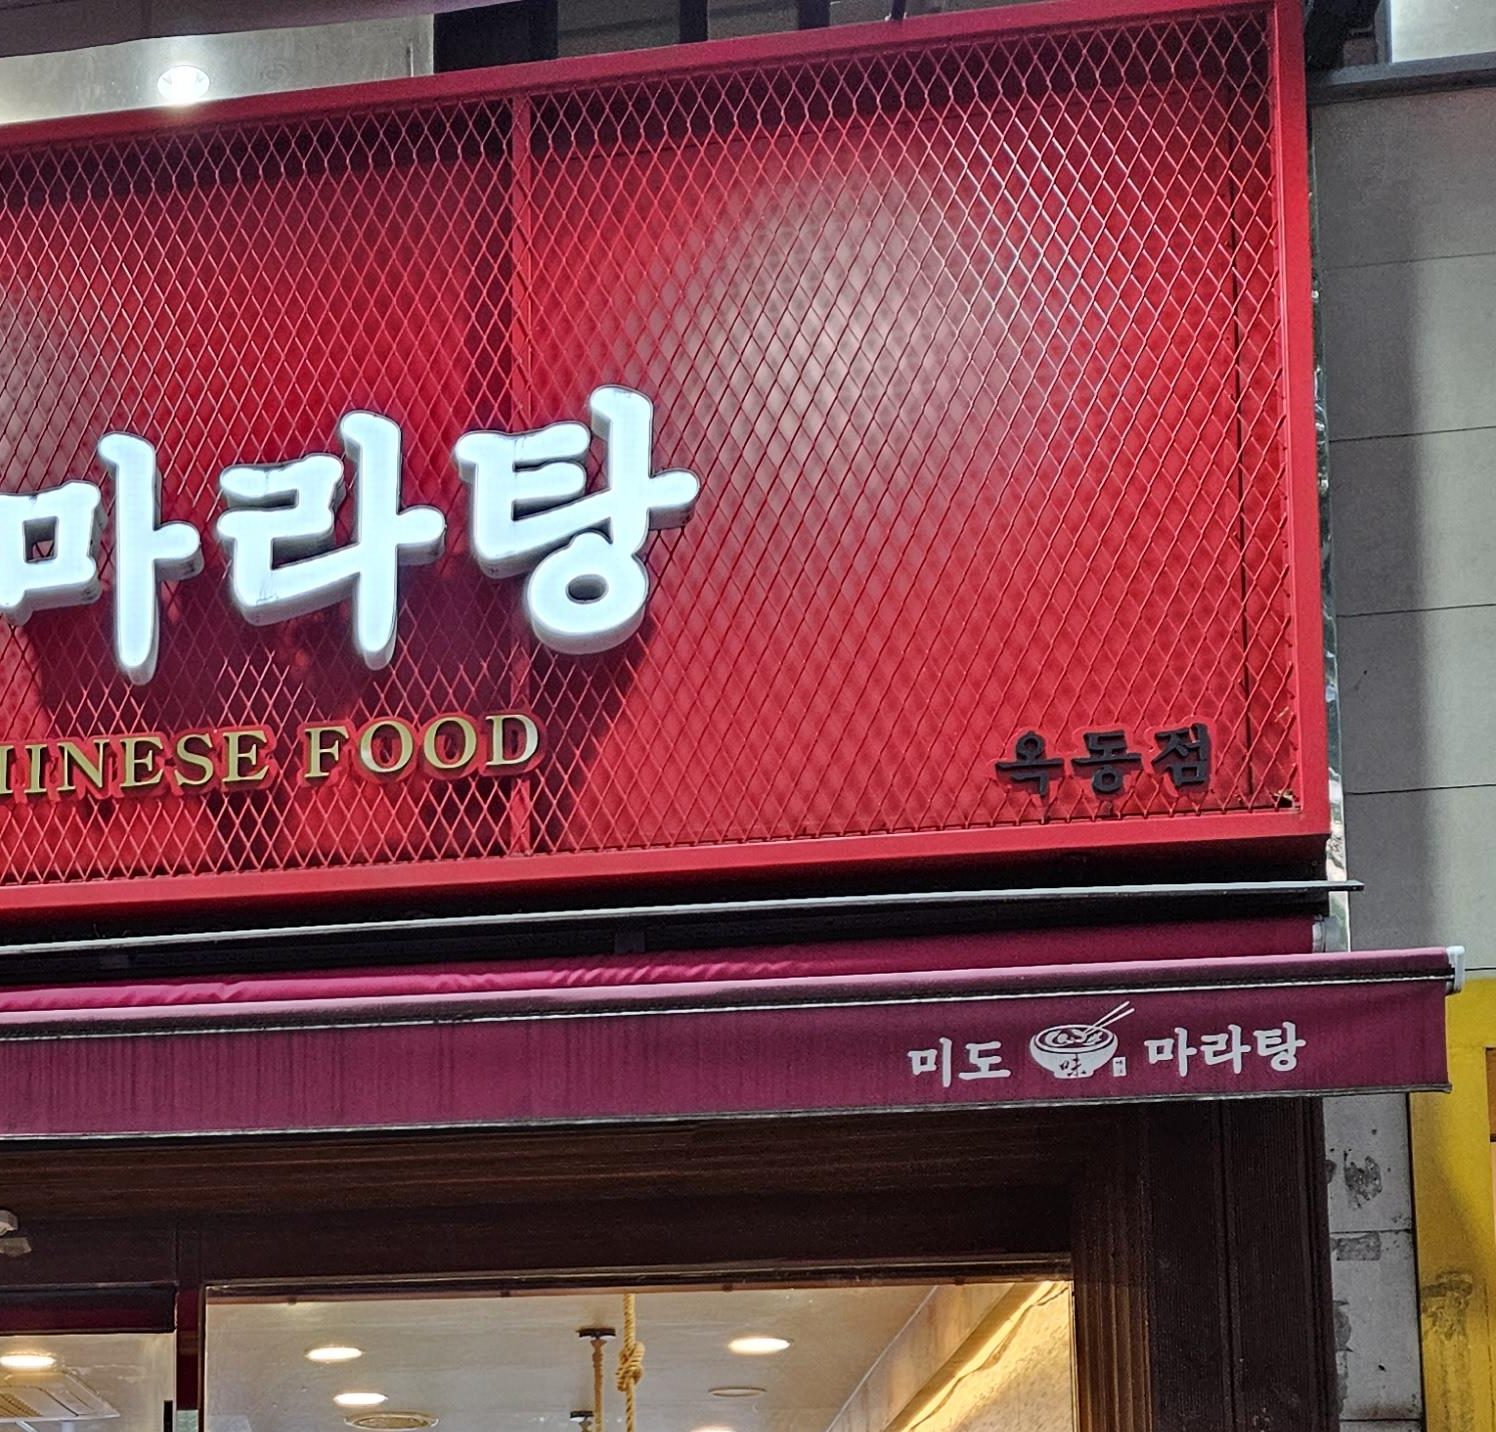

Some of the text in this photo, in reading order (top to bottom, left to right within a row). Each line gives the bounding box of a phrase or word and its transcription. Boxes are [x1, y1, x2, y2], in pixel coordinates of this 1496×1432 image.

[304, 711, 541, 784] FOOD
[995, 722, 1212, 797] 옥동점
[907, 1021, 1306, 1088] 미도 마라탕
